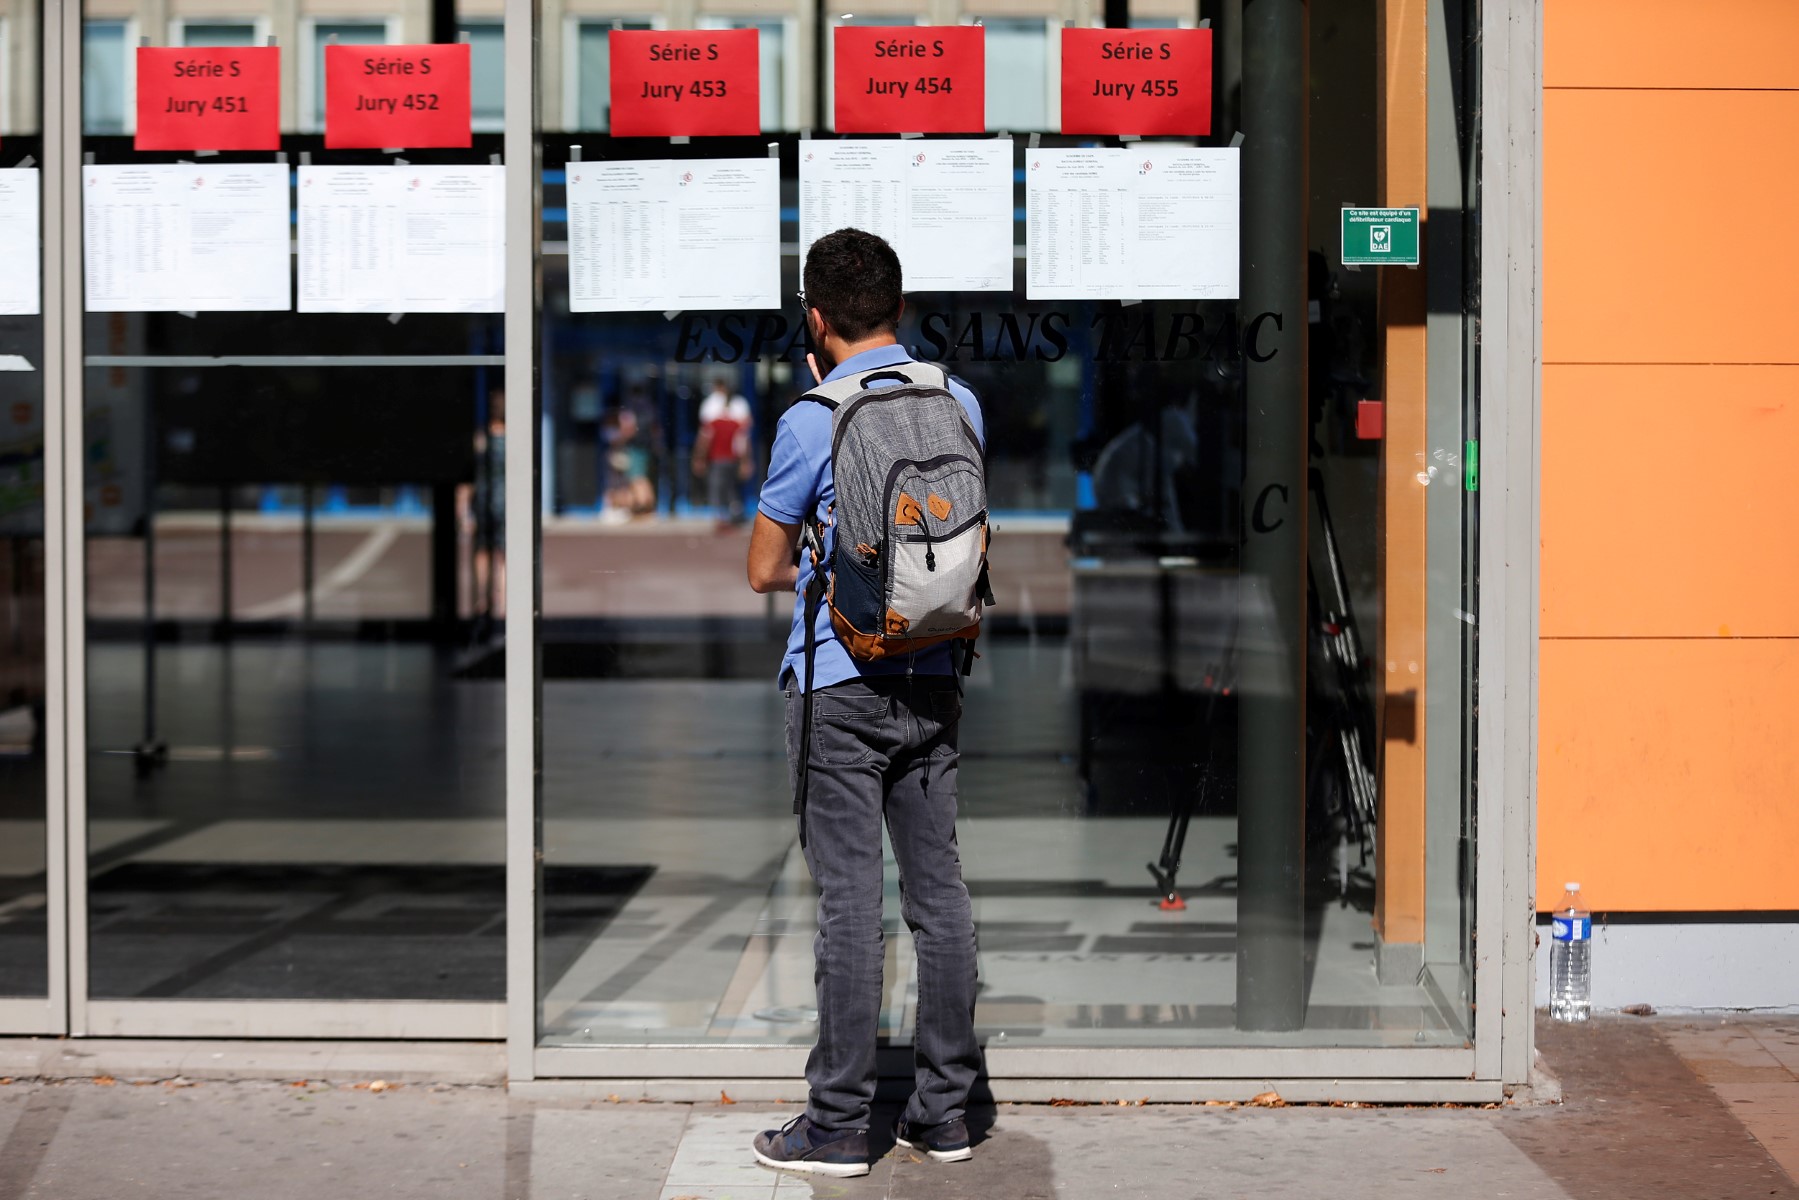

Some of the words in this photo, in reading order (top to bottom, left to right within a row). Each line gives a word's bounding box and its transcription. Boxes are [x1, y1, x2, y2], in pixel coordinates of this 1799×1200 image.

[647, 44, 700, 62] Série
[707, 44, 719, 61] S
[874, 40, 927, 58] Série
[932, 40, 945, 58] S
[1101, 42, 1154, 60] Série
[1159, 42, 1171, 60] S
[173, 60, 223, 78] Série
[229, 60, 241, 77] S
[363, 58, 415, 76] Série
[420, 58, 432, 75] S
[641, 81, 683, 102] Jury
[689, 80, 727, 98] 453
[866, 78, 908, 99] Jury
[914, 77, 953, 95] 454
[1092, 80, 1135, 101] Jury
[1141, 79, 1179, 97] 455
[165, 96, 206, 116] Jury
[212, 96, 248, 113] 451
[355, 94, 397, 115] Jury
[402, 93, 439, 111] 452
[916, 311, 1070, 362] SANS
[1091, 311, 1283, 363] TABAC
